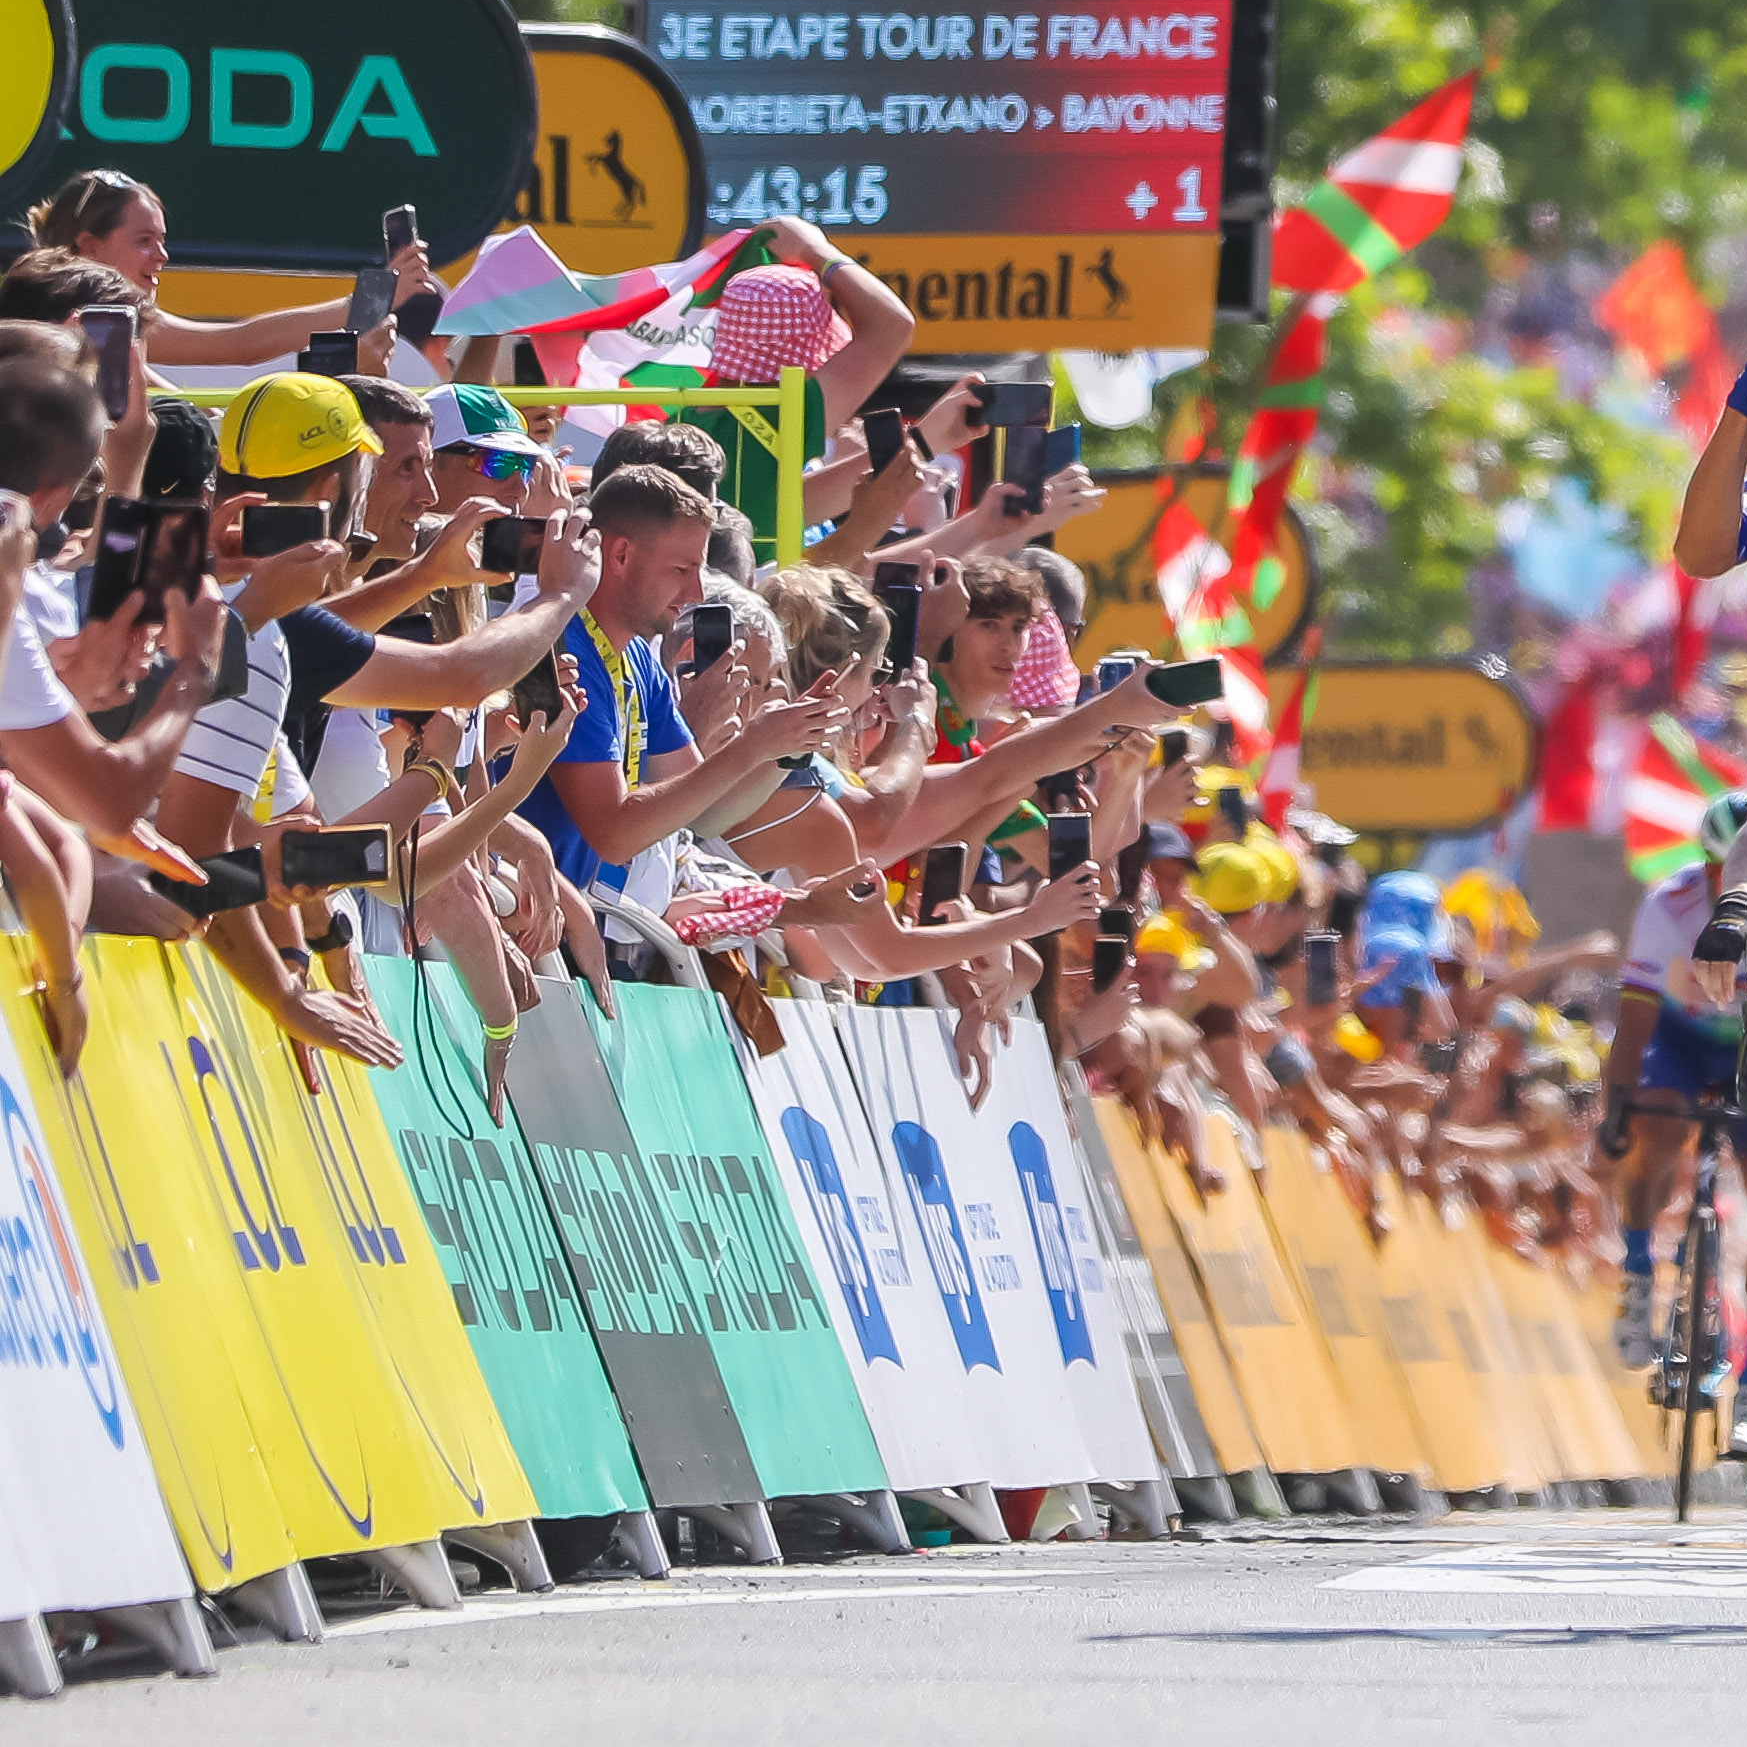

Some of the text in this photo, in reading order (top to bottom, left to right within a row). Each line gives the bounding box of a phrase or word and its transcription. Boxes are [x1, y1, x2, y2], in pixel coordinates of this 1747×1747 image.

[658, 13, 1218, 60] 3E ETAPE TOUR DE FRANCE
[60, 43, 440, 157] ODA
[1061, 93, 1224, 134] BAYONNE
[706, 165, 888, 225] :43:15
[1172, 165, 1209, 224] 1
